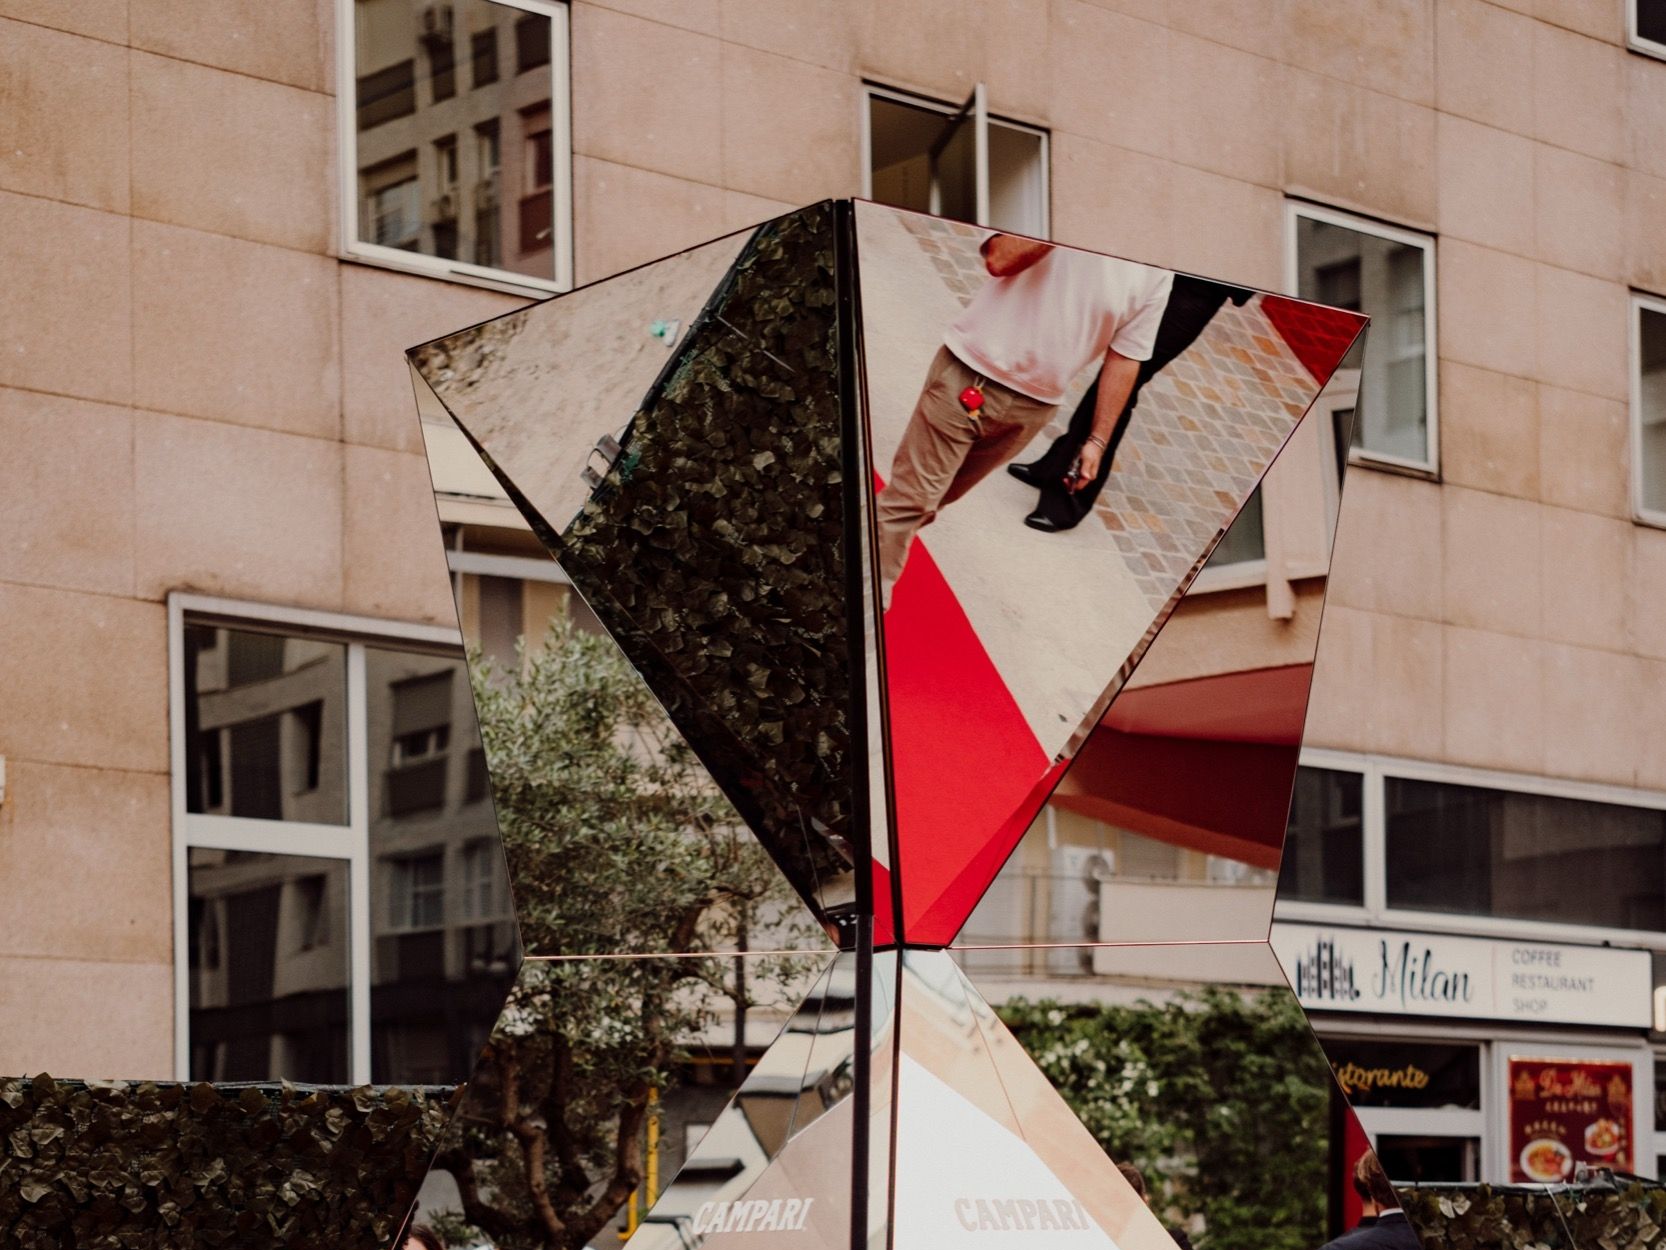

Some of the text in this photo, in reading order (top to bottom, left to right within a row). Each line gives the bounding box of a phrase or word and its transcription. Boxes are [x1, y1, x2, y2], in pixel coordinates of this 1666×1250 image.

[1512, 949, 1561, 967] COFFEE
[1373, 938, 1472, 1007] Milan
[1512, 974, 1595, 993] RESTAURANT
[1513, 997, 1549, 1013] SHOP
[695, 1198, 814, 1234] CAMPARI
[955, 1198, 1091, 1231] CAMPARI
